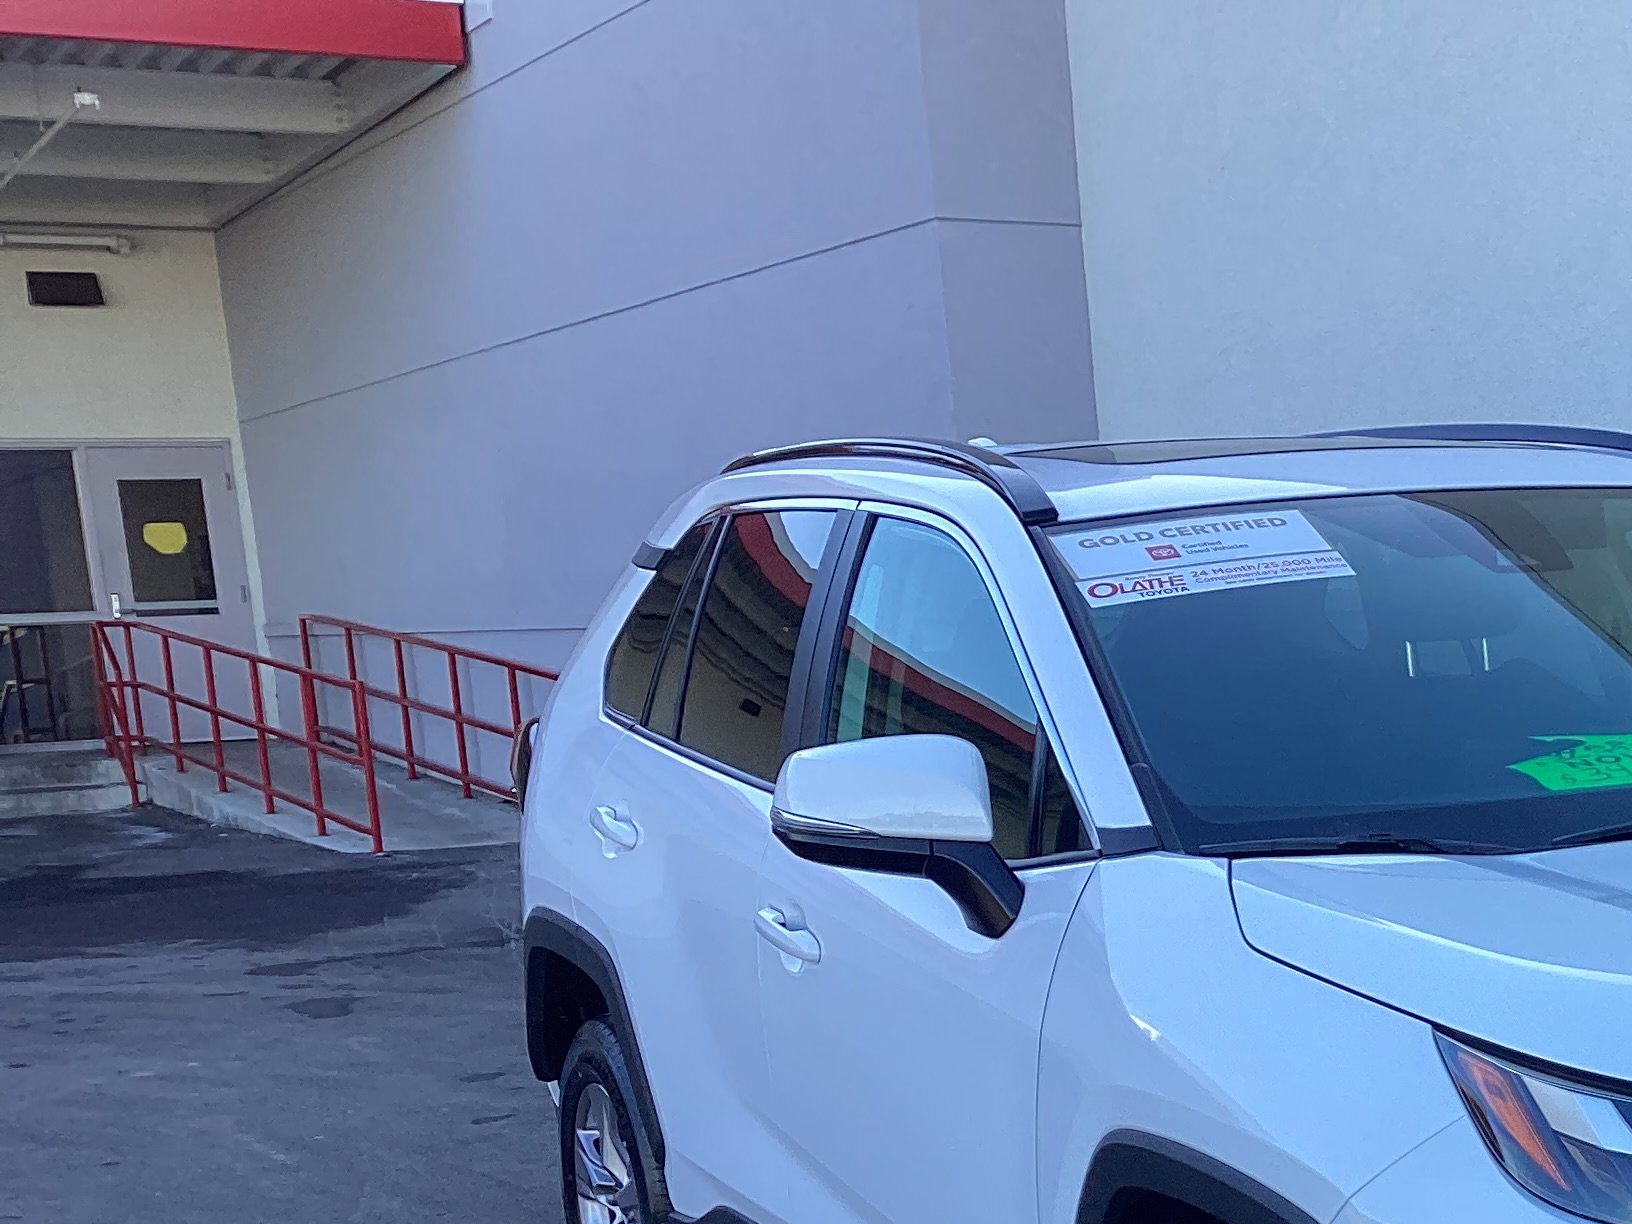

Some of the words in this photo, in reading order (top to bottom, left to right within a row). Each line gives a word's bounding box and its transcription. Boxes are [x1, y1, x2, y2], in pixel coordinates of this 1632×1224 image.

[1078, 531, 1154, 550] GOLD
[1158, 517, 1287, 539] CERTIFIED
[1181, 540, 1222, 549] Certified
[1211, 543, 1249, 552] Vehicles
[1190, 570, 1209, 579] 24
[1315, 556, 1343, 565] Mile
[1195, 569, 1279, 584] Complimentary
[1280, 562, 1348, 574] Maintenance
[1087, 575, 1187, 598] OLATHE
[1137, 586, 1191, 598] TOYOTA
